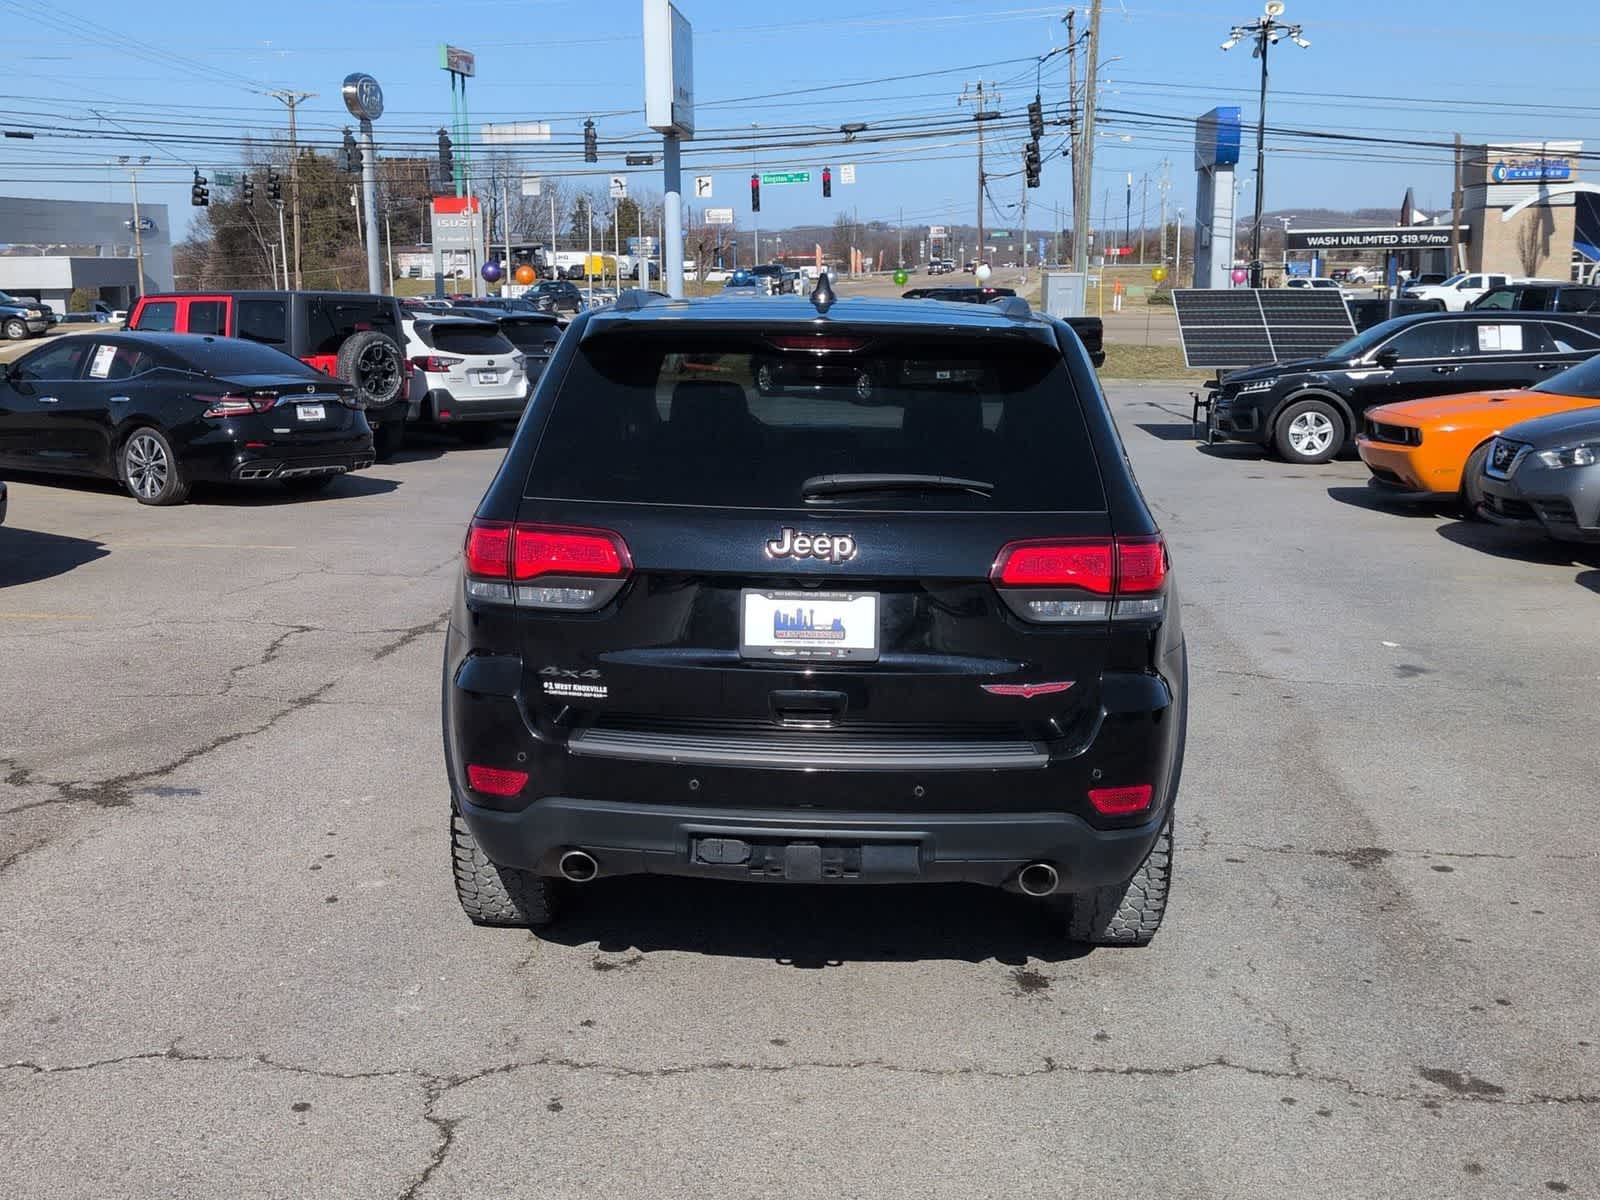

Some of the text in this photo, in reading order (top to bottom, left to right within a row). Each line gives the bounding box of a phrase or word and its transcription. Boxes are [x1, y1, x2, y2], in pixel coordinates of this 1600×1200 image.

[1307, 236, 1339, 246] WASH
[1341, 235, 1399, 245] UNLIMITED
[767, 527, 856, 563] Jeep
[554, 682, 572, 690] WEST
[572, 684, 608, 694] KNOXVILLE
